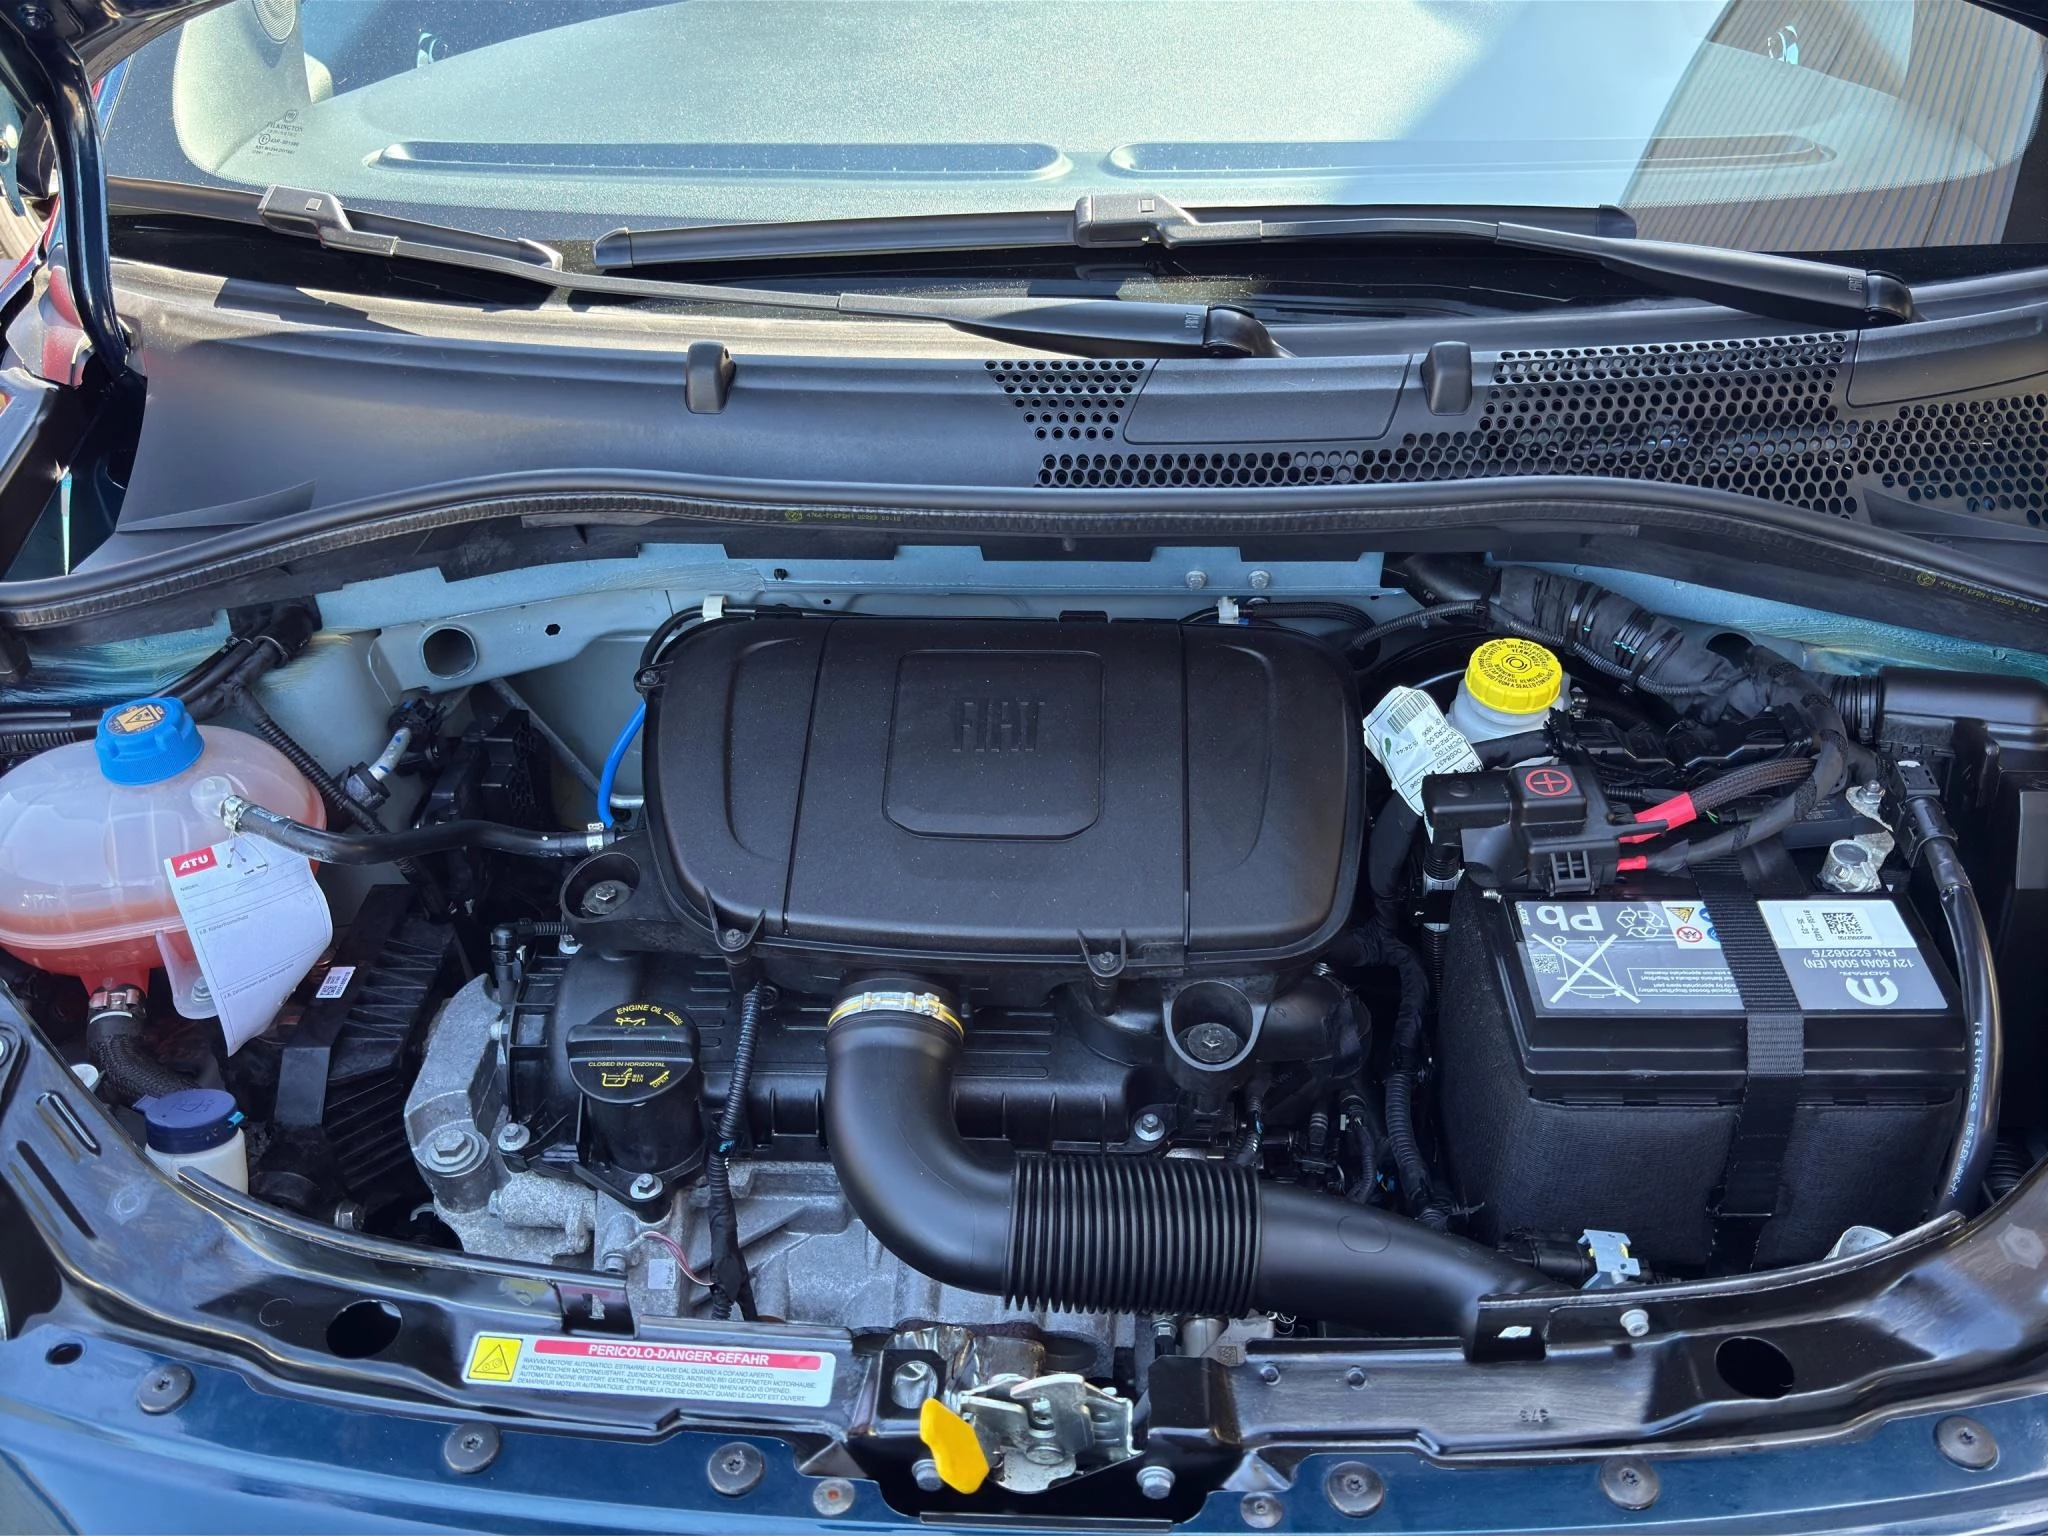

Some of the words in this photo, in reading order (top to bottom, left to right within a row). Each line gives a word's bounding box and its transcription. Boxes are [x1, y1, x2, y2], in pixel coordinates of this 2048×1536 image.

[952, 698, 1046, 752] FIAT
[179, 854, 208, 870] ATU
[1536, 906, 1604, 931] Pb
[1811, 949, 1871, 958] 52206275
[1873, 949, 1897, 957] PN:
[1804, 958, 1828, 968] (EN)
[1829, 958, 1859, 968] 500A
[1861, 958, 1890, 968] 50Ah
[1893, 958, 1914, 968] 12V
[616, 1004, 650, 1015] ENGINE
[650, 1006, 662, 1015] OIL
[1970, 1022, 1984, 1112] italtrecce
[652, 1074, 669, 1088] OPEN
[1959, 1136, 1972, 1160] FLEX
[588, 1344, 770, 1365] PERICOLO-DANGER-GEFAHR
